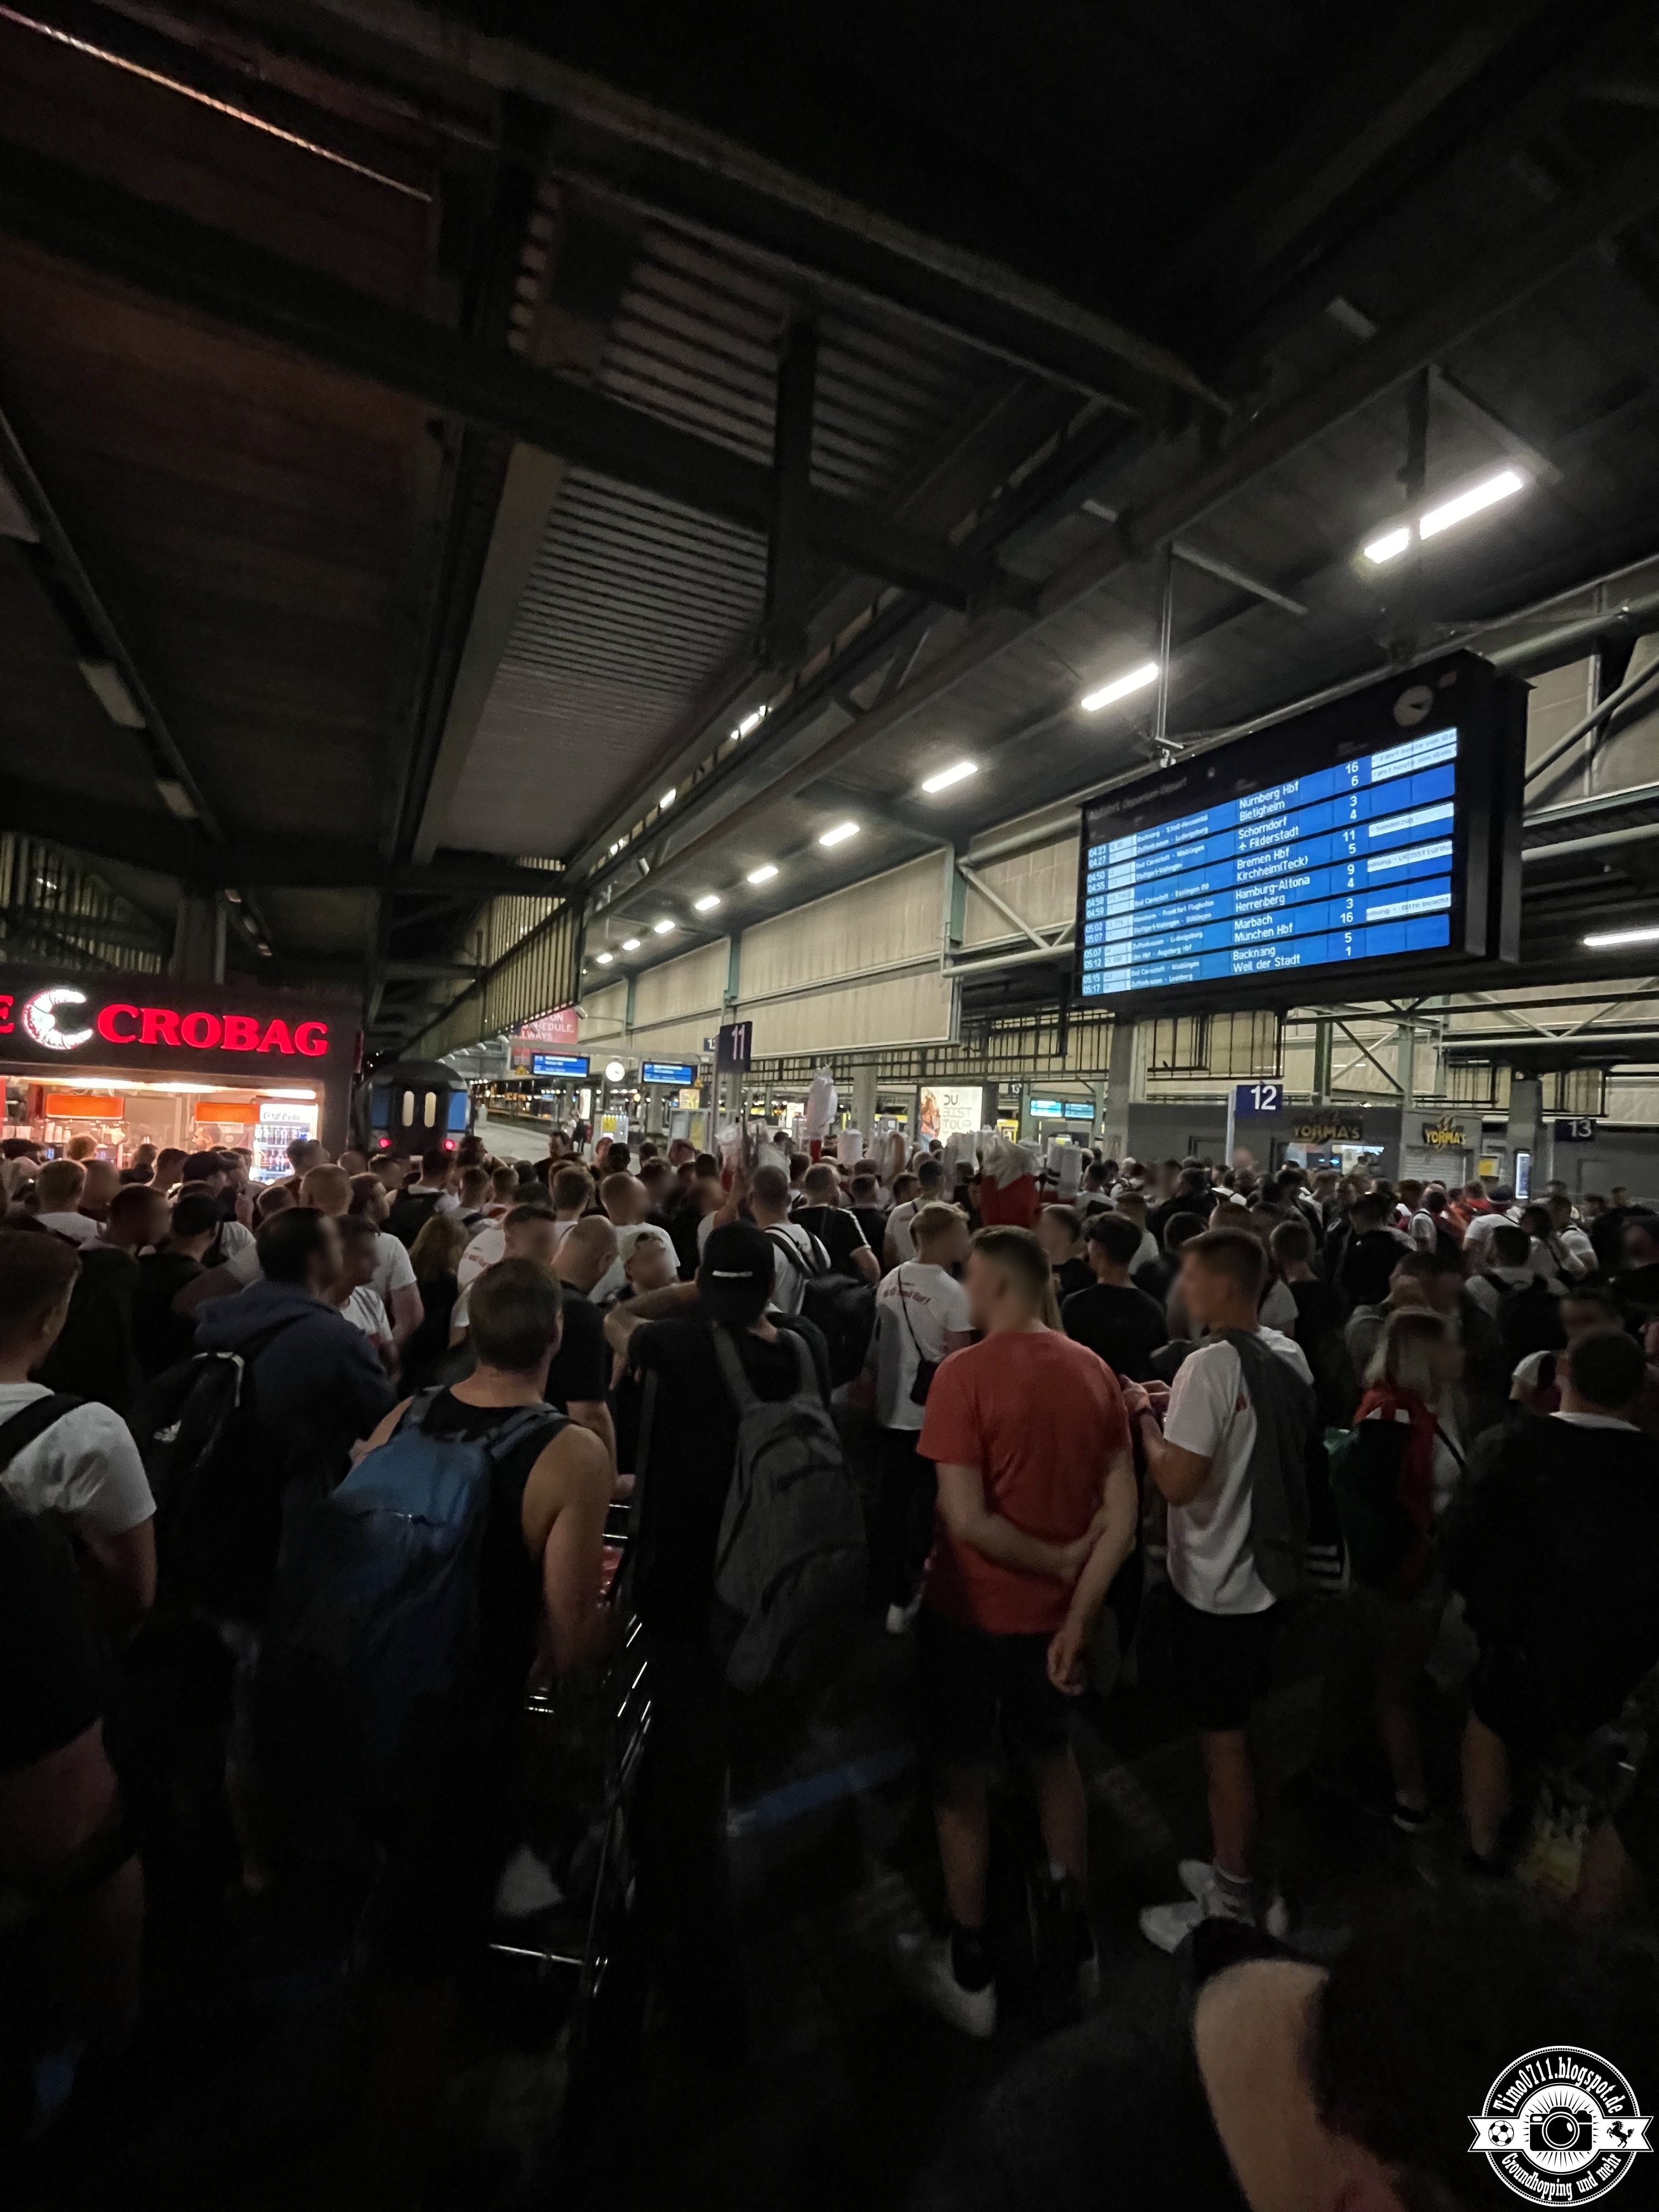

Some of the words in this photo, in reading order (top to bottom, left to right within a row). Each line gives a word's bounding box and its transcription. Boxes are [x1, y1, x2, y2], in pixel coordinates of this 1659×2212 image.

[1283, 781, 1299, 795] Hbf
[1345, 761, 1359, 774] 16
[1239, 800, 1285, 821] Bietigheim
[1351, 775, 1359, 786] 6
[1238, 816, 1287, 839] Schorndorf
[1350, 795, 1357, 806] 3
[1249, 826, 1299, 848] Filderstadt
[1350, 809, 1357, 820] 4
[1237, 854, 1271, 870] Bremen
[1274, 847, 1289, 860] Hbf
[1342, 830, 1355, 842] 11
[1237, 855, 1308, 882] Kirchheim(Teck)
[1348, 843, 1356, 854] 5
[1235, 877, 1310, 900] Hamburg-Altona
[1347, 864, 1355, 875] 9
[1236, 895, 1285, 912] Herrenberg
[1347, 878, 1355, 888] 4
[1234, 915, 1273, 930] Marbach
[1346, 898, 1353, 909] 3
[1277, 923, 1293, 935] Hbf
[1340, 912, 1353, 923] 16
[1233, 946, 1276, 961] Backnang
[1344, 932, 1352, 943] 5
[1233, 962, 1253, 973] Weil
[1256, 960, 1272, 969] der
[1274, 954, 1301, 967] Stadt
[1345, 946, 1351, 957] 1
[98, 1003, 328, 1056] CROBAG
[519, 1030, 553, 1042] LWAYS
[708, 1039, 715, 1049] 1
[732, 1024, 745, 1060] 11
[1251, 1085, 1277, 1110] 12
[1293, 1125, 1360, 1139] YORMA'S
[1426, 1130, 1466, 1144] YORMA'S
[1567, 1120, 1592, 1137] 13
